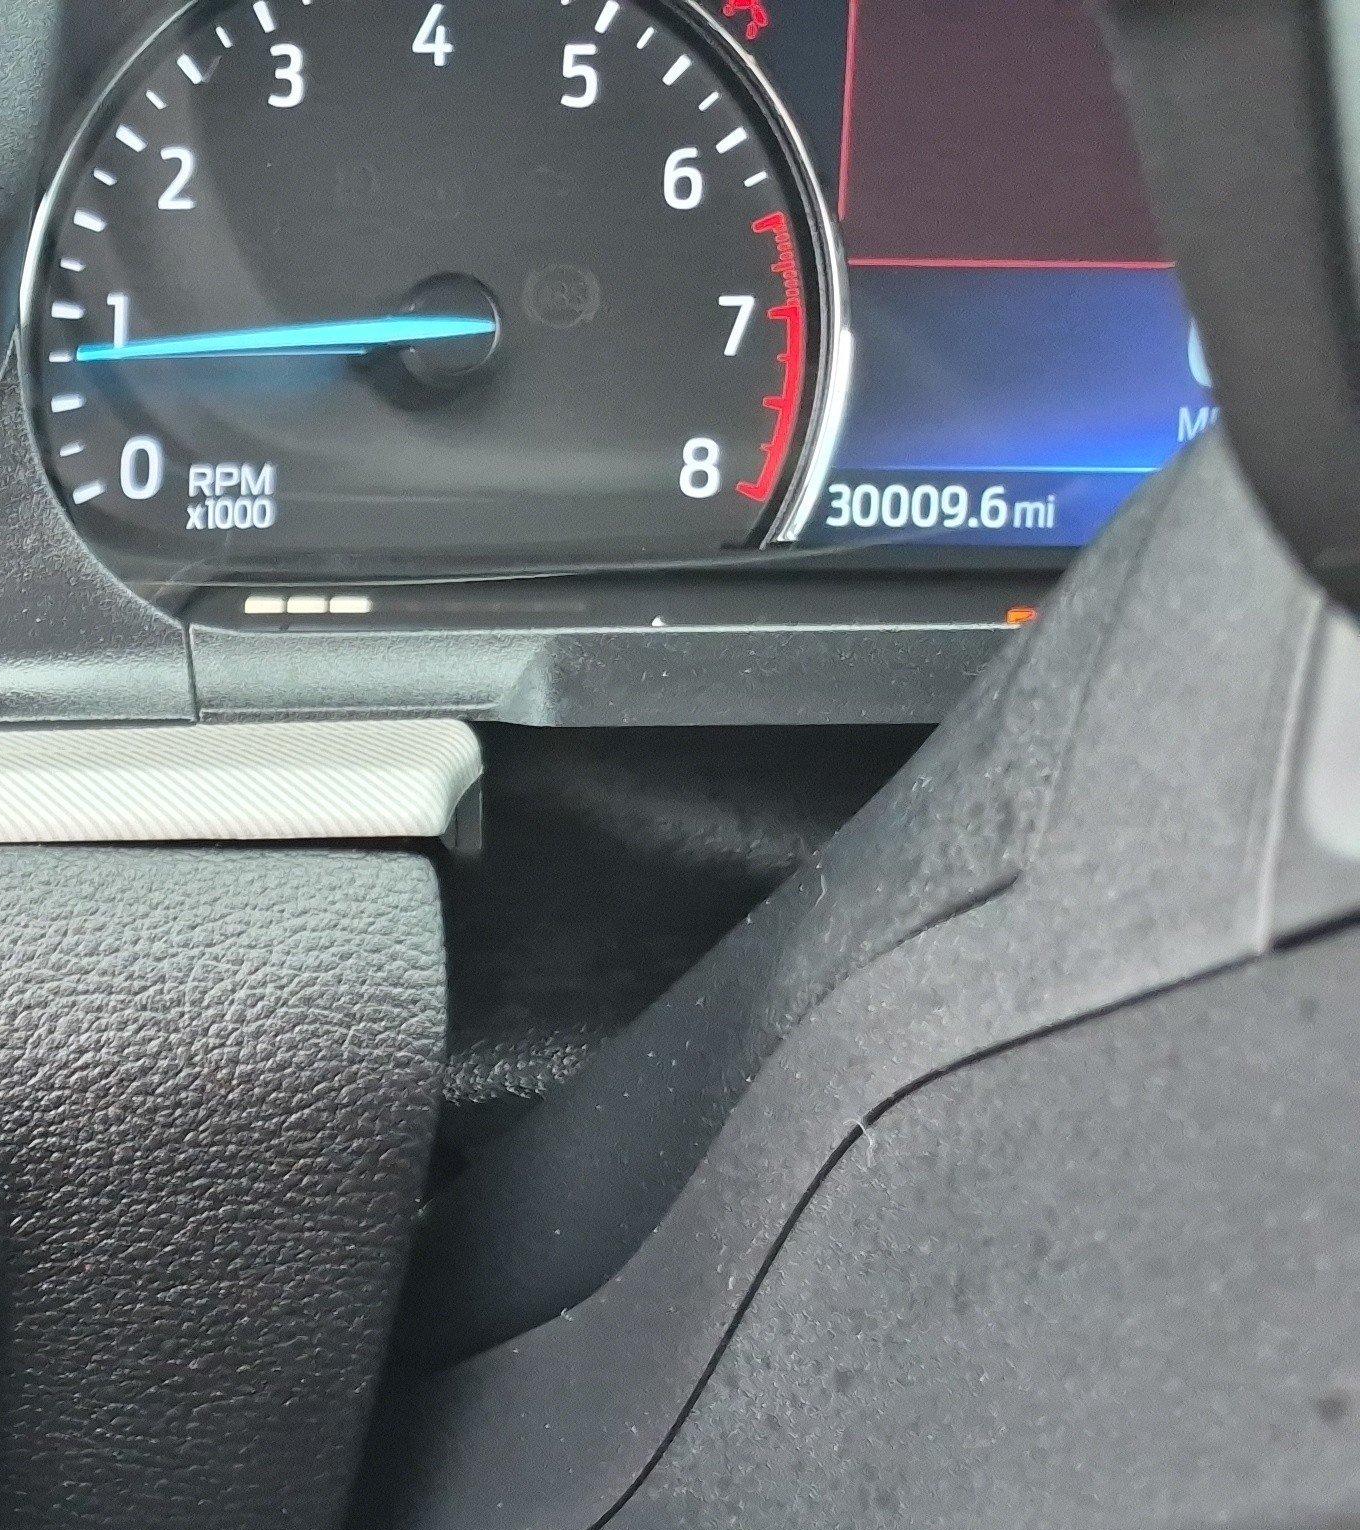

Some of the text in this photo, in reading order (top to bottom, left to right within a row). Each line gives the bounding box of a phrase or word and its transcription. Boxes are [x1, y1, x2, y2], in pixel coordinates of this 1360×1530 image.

[411, 3, 454, 67] 4
[267, 43, 305, 108] 3
[560, 43, 599, 108] 5
[157, 146, 196, 210] 2
[663, 146, 704, 210] 6
[106, 292, 130, 349] 1
[718, 295, 756, 357] 7
[120, 437, 164, 500] 0
[188, 461, 277, 497] RPM
[679, 437, 723, 499] 8
[185, 497, 277, 530] x1000
[826, 483, 1008, 528] 30009.6
